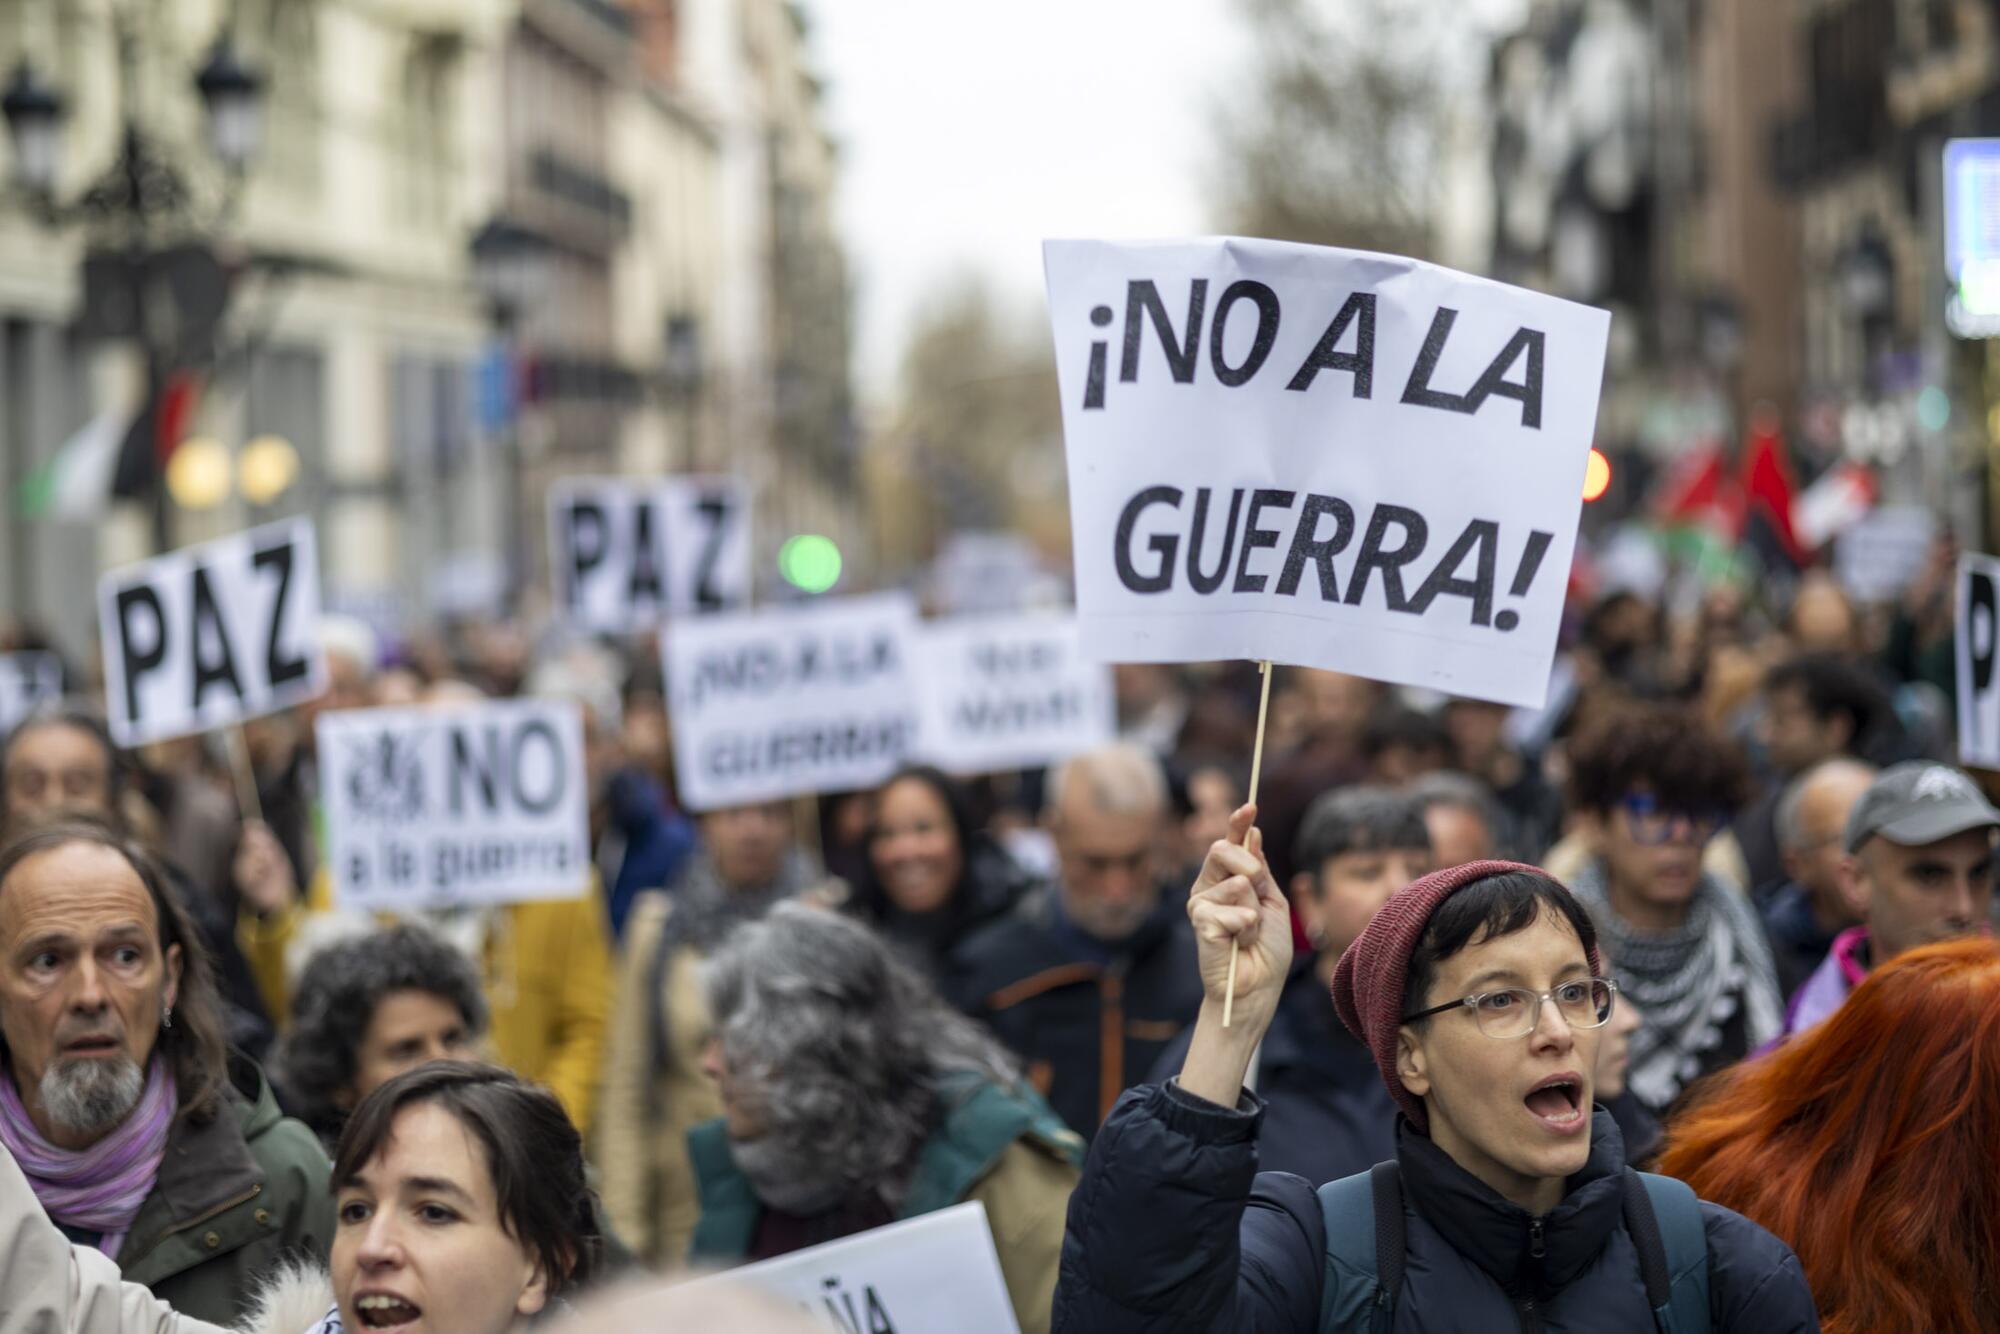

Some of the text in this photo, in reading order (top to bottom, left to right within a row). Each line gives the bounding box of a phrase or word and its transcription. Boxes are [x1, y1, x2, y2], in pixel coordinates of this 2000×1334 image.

[1083, 278, 1546, 431] ¡NO A LA
[569, 496, 735, 612] PAZ
[1112, 484, 1554, 632] GUERRA!
[116, 543, 309, 722] PAZ
[447, 721, 566, 816] NO
[346, 838, 572, 889] a la guerra
[819, 1275, 899, 1334] ÑA
